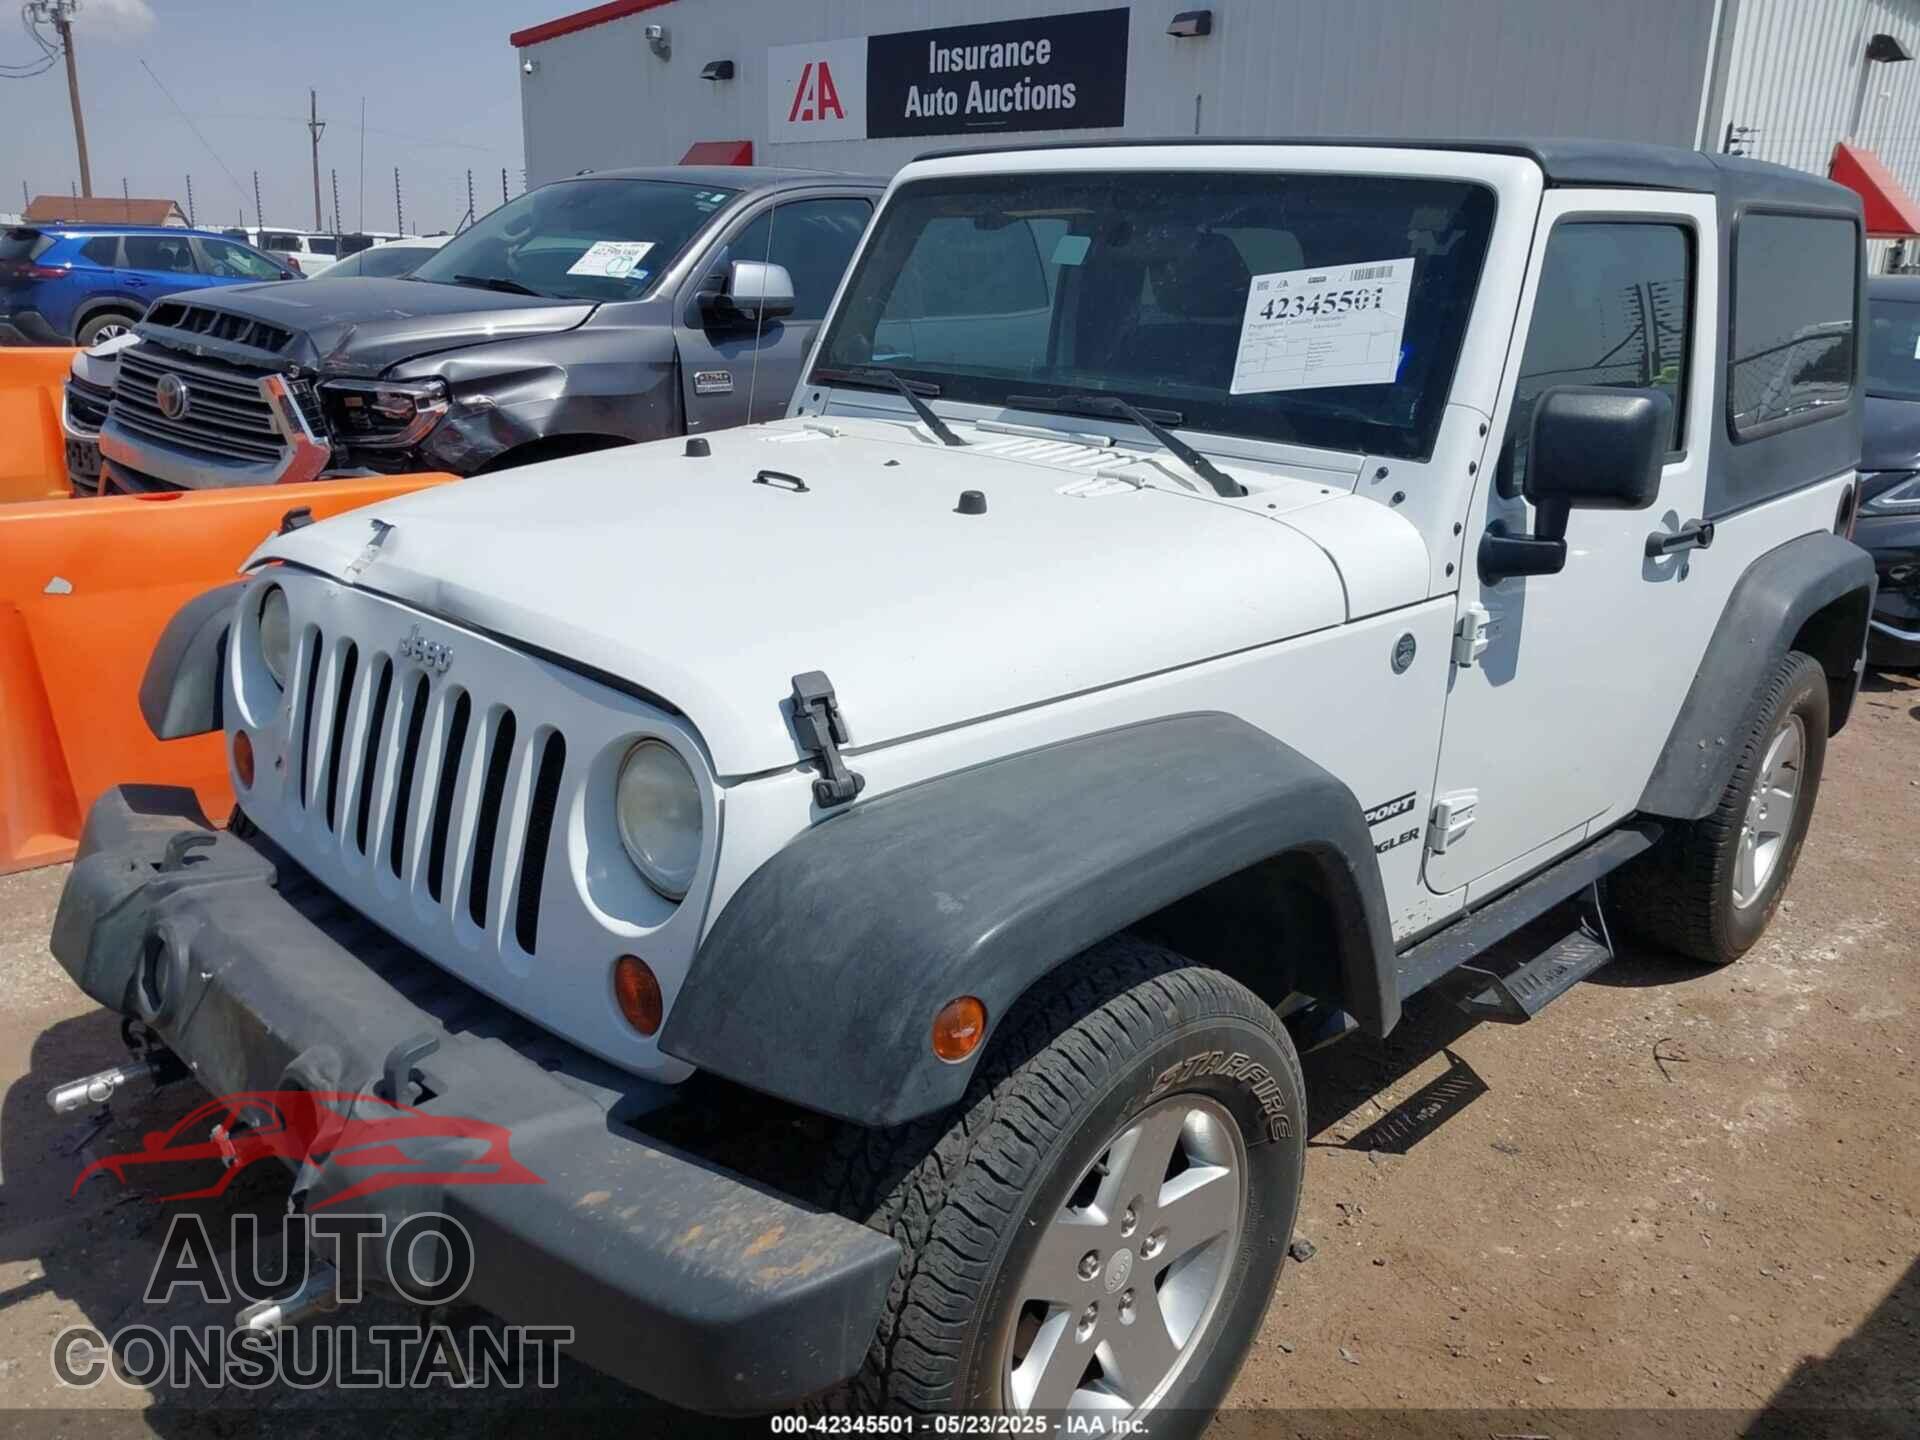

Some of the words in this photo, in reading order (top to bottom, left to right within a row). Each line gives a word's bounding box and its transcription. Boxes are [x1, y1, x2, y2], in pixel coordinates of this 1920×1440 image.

[929, 38, 1052, 74] Insurance
[904, 86, 958, 118] Auto
[964, 76, 1077, 115] Auctions
[1259, 287, 1384, 320] 42345501
[1364, 798, 1411, 822] PORT
[1374, 827, 1420, 854] GLER
[1144, 1050, 1293, 1142] STARFIRE
